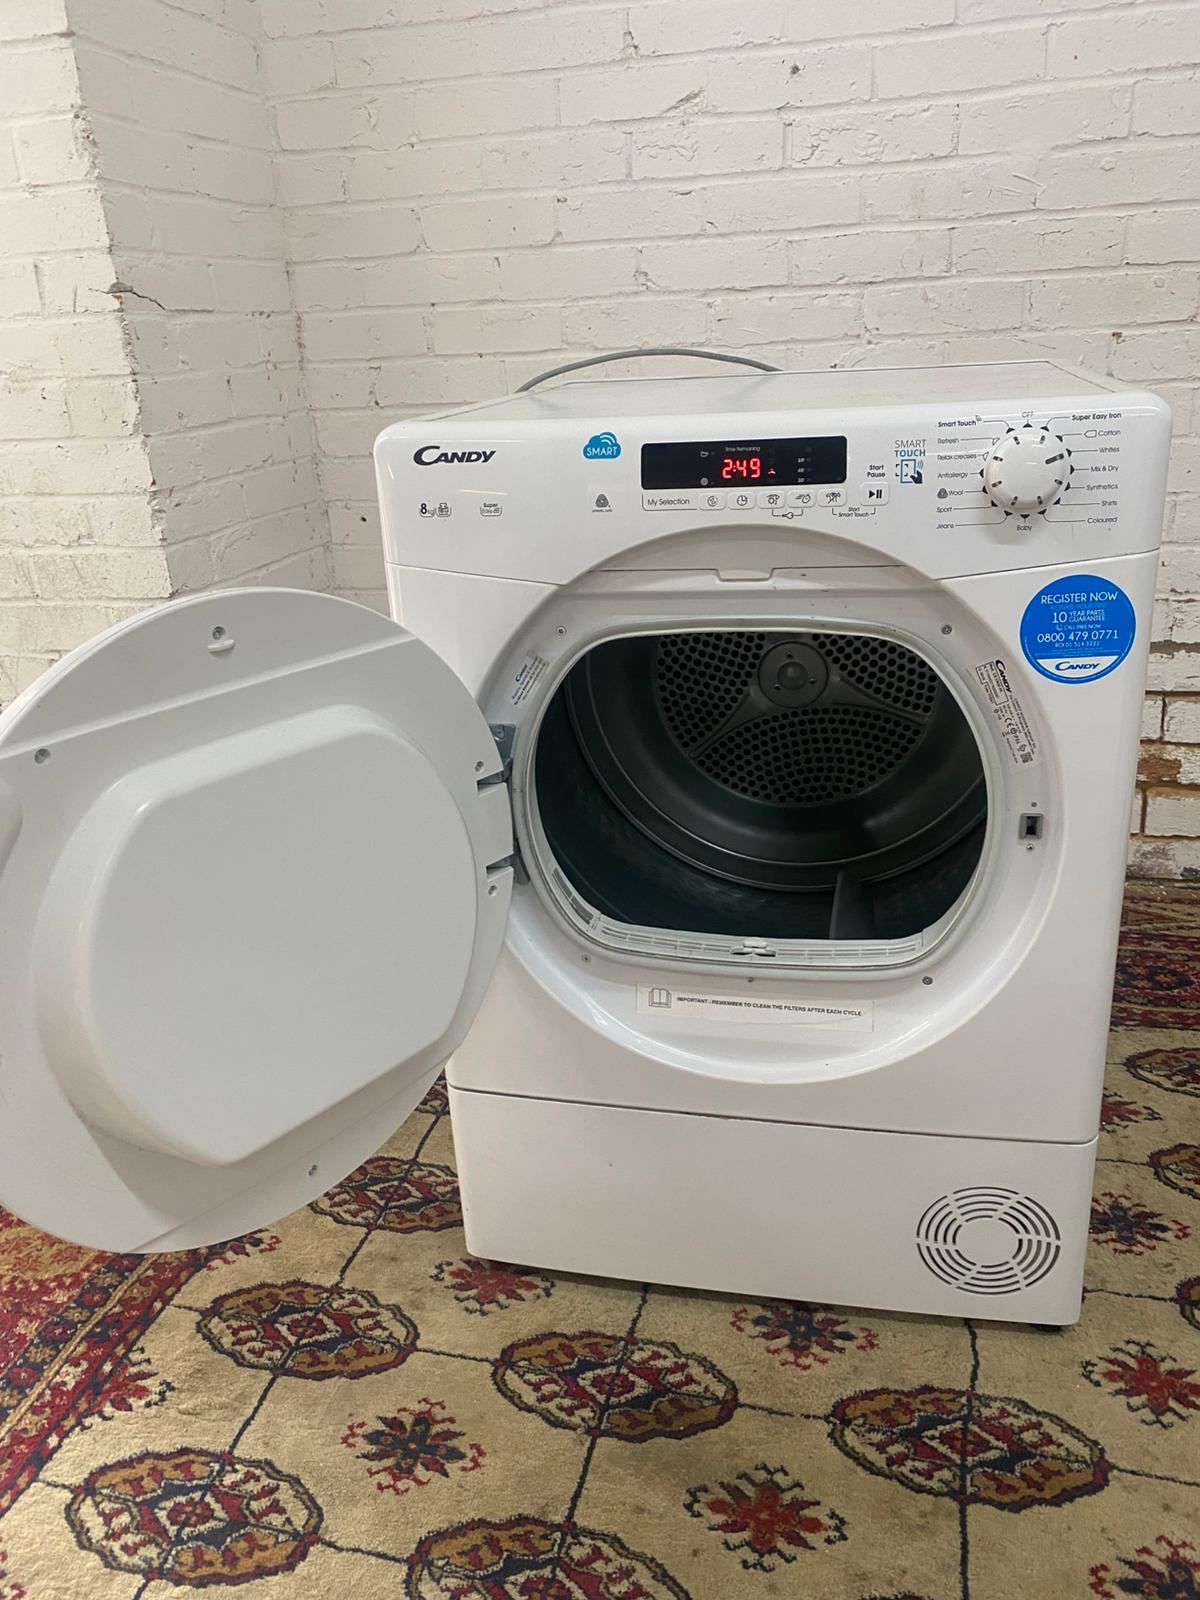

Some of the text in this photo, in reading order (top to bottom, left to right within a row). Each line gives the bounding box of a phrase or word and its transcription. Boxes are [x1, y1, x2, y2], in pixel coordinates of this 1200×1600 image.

[1072, 412, 1122, 421] Super Easy Iron
[954, 419, 977, 427] Touch
[1098, 429, 1121, 437] Cotton
[895, 439, 927, 448] SMART
[937, 437, 960, 445] Refresh
[586, 446, 618, 457] SMART
[736, 445, 761, 453] Remaining
[895, 449, 926, 458] TOUCH
[1098, 446, 1120, 454] Whites
[413, 445, 497, 466] CANDY
[722, 458, 761, 478] 2:49
[1090, 465, 1101, 473] Mix
[1107, 464, 1119, 473] Dry
[937, 471, 968, 479] Antiallergy
[1086, 483, 1118, 491] Synthetics
[647, 496, 690, 506] My Selection
[936, 506, 953, 514] Sport
[1087, 516, 1118, 524] Coloured
[936, 522, 954, 530] Jeans
[1016, 524, 1032, 532] Baby
[1041, 591, 1119, 605] REGISTER NOW
[1052, 611, 1067, 624] 10
[1068, 615, 1105, 623] GUARANTEE
[1037, 629, 1119, 643] 0800 479 0771
[1055, 661, 1100, 671] CANDY
[995, 659, 1012, 693] CANDY
[677, 996, 708, 1005] IMPORTANT
[711, 999, 743, 1007] REMEMBER
